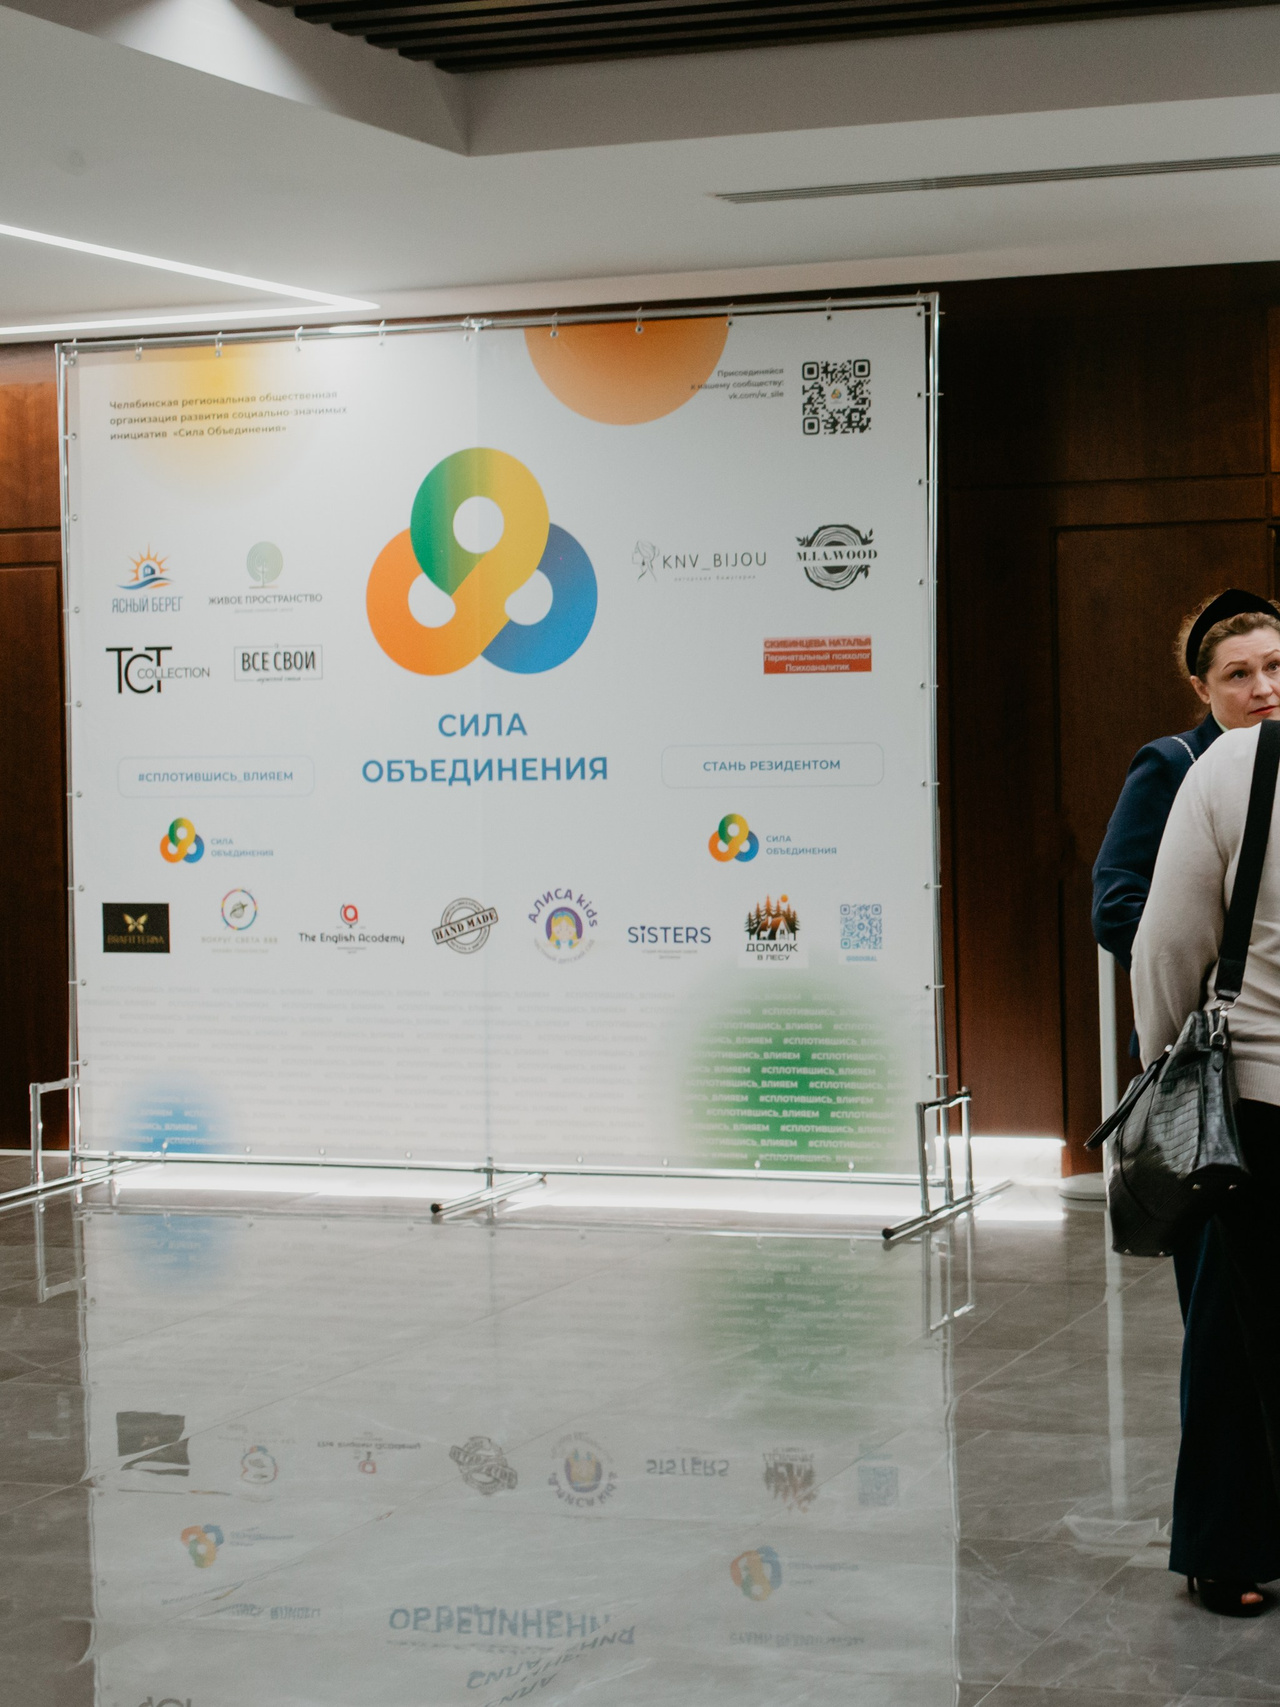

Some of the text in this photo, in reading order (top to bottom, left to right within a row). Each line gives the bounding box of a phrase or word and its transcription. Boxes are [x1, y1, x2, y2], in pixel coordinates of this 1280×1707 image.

[717, 368, 784, 378] Присоединяйся
[697, 382, 730, 390] нашему
[732, 379, 784, 388] сообществу:
[109, 391, 338, 410] Челябинская региональная общественная
[109, 406, 347, 426] организация развития социально-значимых
[110, 424, 287, 440] инициатив «Сила Объединения»
[663, 551, 767, 571] KNV_BIJOU
[797, 549, 877, 561] M.I.A.WOOD
[112, 595, 183, 613] ЯСНЫЙ БЕРЕГ
[208, 594, 323, 606] ЖИВОЕ ПРОСТРАНСТВО
[829, 638, 871, 647] НАТАЛЬЯ
[241, 650, 316, 672] ВСЕ СВОИ
[764, 653, 870, 663] Перинатальный психолог
[137, 667, 210, 679] COLLECTION
[785, 664, 850, 672] Психоаналитик
[438, 713, 528, 738] СИЛА
[361, 757, 609, 787] ОБЪЕДИНЕНИЯ
[703, 759, 841, 773] СТАНЬ РЕЗИДЕНТОМ
[138, 770, 294, 784] #СПЛОТИВШИСЬ_ВЛИЯЕМ
[210, 838, 234, 846] СИЛА
[766, 834, 792, 843] СИЛА
[210, 849, 274, 858] ОБЪЕДИНЕНИЯ
[766, 846, 837, 857] ОБЪЕДИНЕНИЯ
[528, 888, 598, 927] АЛИСА kids
[435, 923, 465, 940] HAND
[466, 912, 494, 927] MADE
[298, 933, 405, 944] The English Academy
[745, 943, 799, 953] ДОМИК
[765, 954, 791, 962] ЛЕСУ
